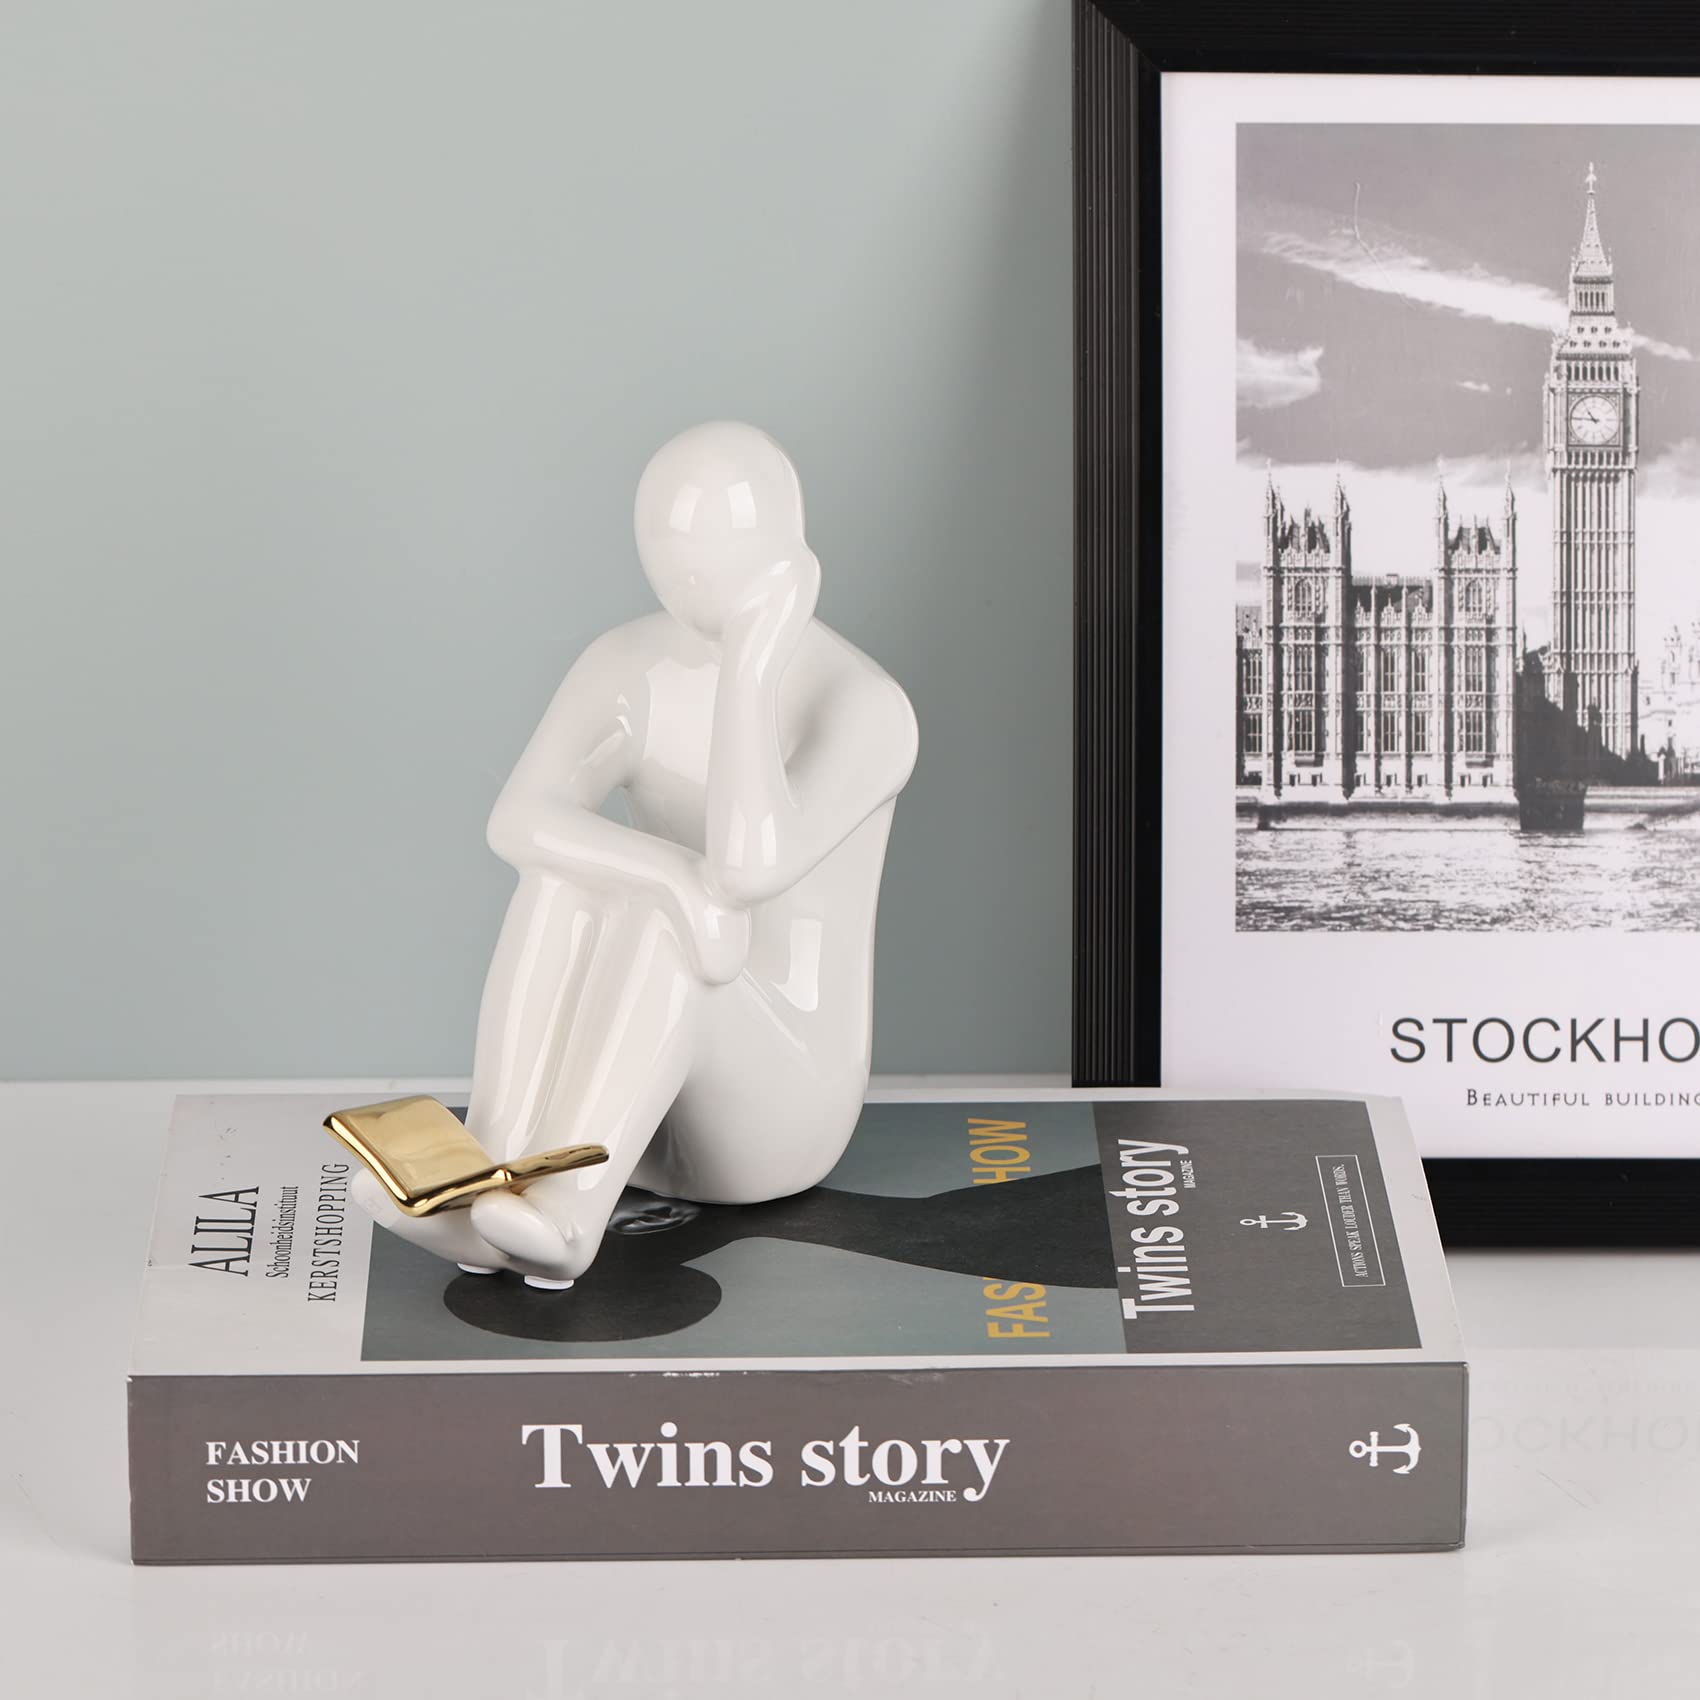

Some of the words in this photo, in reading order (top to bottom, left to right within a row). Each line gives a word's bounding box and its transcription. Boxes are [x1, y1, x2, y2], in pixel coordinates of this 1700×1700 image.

[1391, 1017, 1700, 1063] STOCKHO
[1109, 1139, 1189, 1216] story
[1180, 1160, 1196, 1189] MAGAZINE
[1336, 1187, 1352, 1203] THAN
[189, 1186, 260, 1277] ALILA
[265, 1185, 299, 1279] Schoonheidsinstituut
[307, 1163, 350, 1302] KERSTSHOPPING
[1341, 1205, 1358, 1229] LOUDER
[1346, 1230, 1362, 1251] SPEAK
[1117, 1226, 1195, 1319] Twins
[1351, 1252, 1368, 1277] ACTIONS
[982, 1276, 1051, 1338] FAS
[206, 1440, 360, 1465] FASHION
[521, 1421, 774, 1489] Twins
[801, 1425, 1011, 1502] story
[206, 1478, 312, 1503] SHOW
[868, 1490, 957, 1502] MAGAZINE
